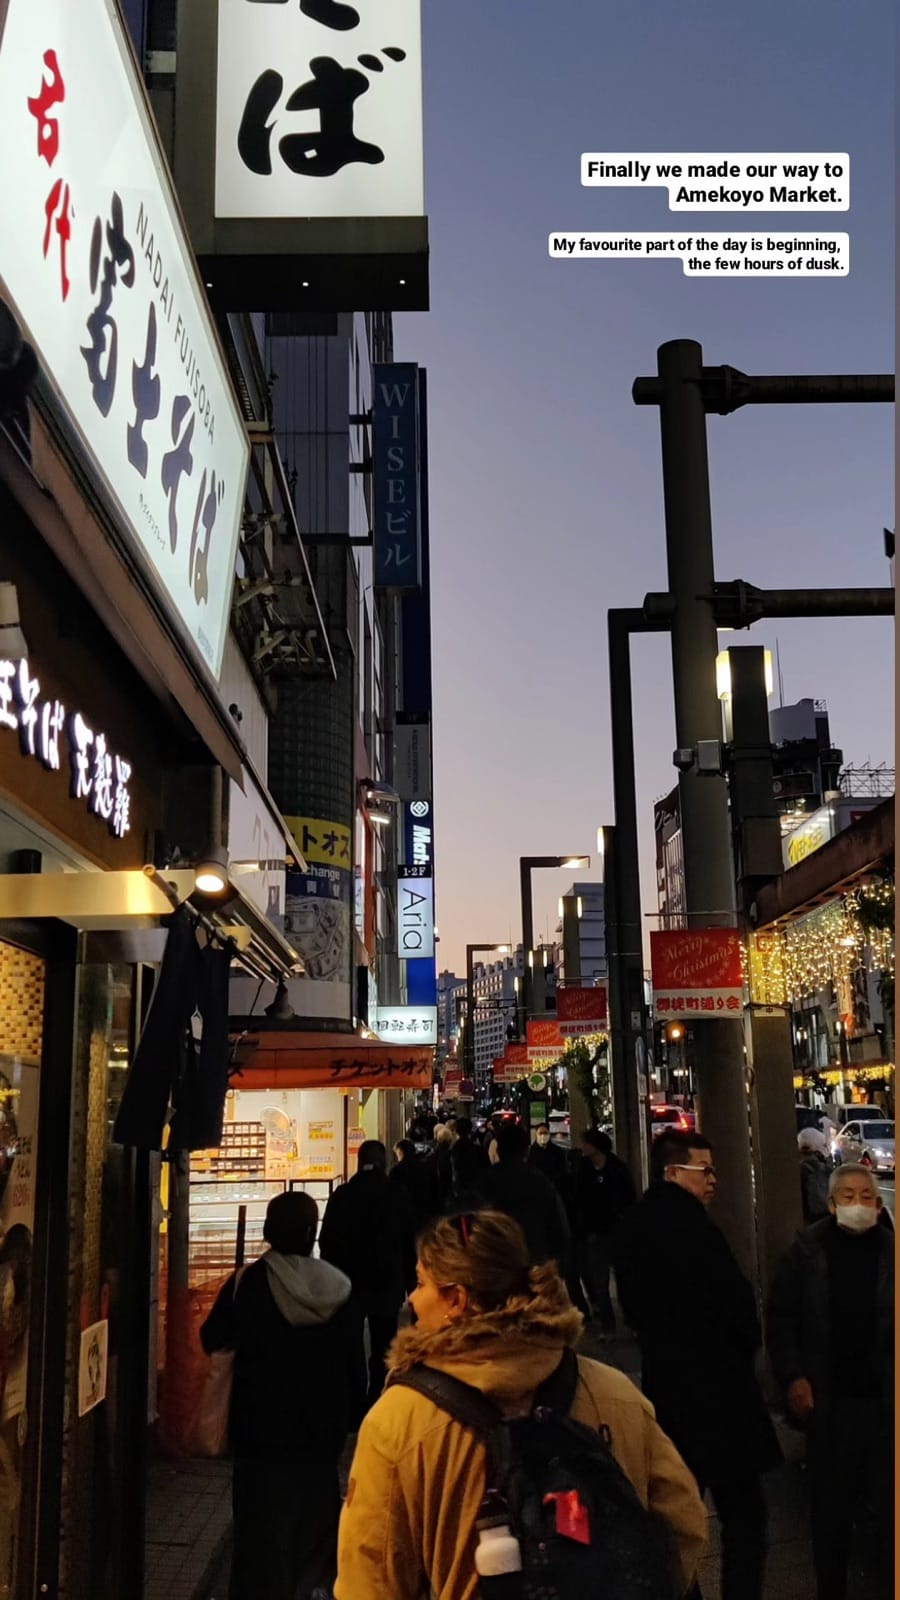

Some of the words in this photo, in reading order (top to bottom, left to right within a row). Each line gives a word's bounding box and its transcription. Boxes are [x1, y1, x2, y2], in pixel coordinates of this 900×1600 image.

[238, 0, 407, 177] ば
[136, 201, 174, 322] NADAI
[174, 313, 216, 444] FUJISOBA
[402, 888, 427, 950] Aria
